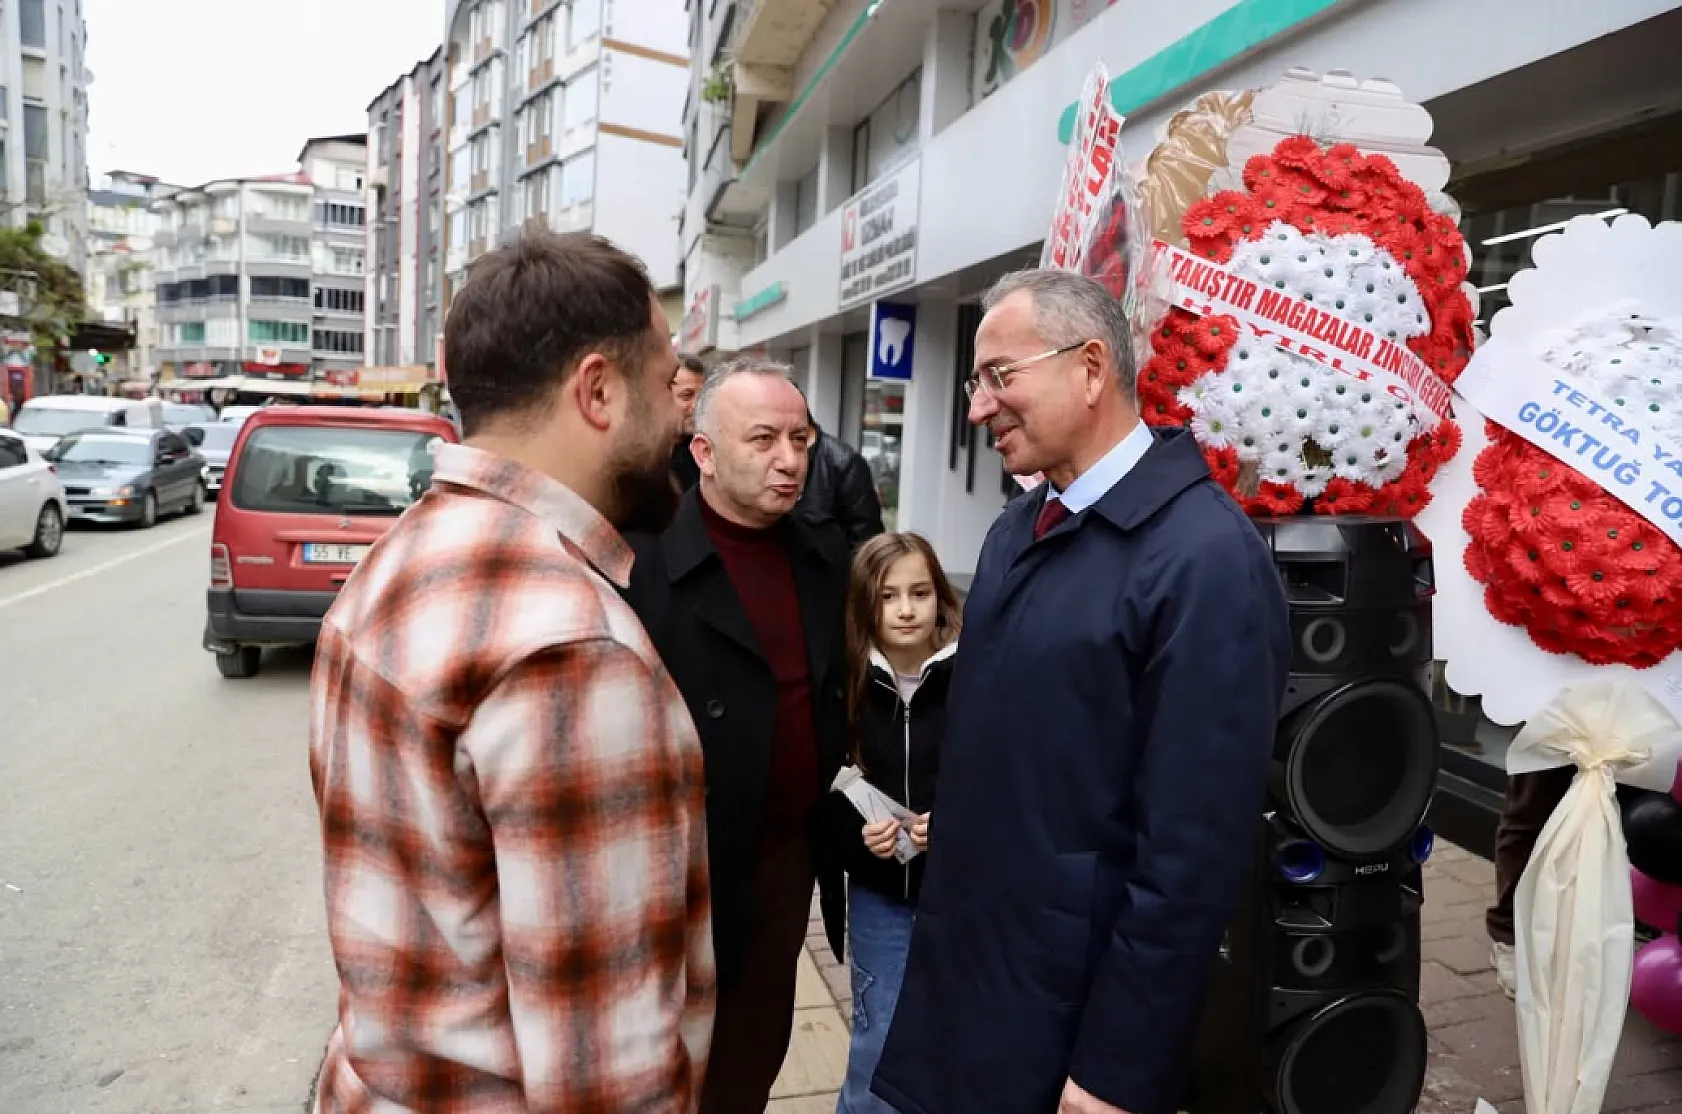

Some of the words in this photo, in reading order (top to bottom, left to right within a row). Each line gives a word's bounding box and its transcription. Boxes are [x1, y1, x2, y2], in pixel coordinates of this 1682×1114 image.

[1171, 252, 1258, 311] TAKIŞTIR
[1254, 288, 1374, 360] MAĞAZALAR
[1517, 400, 1643, 486] GÖKTUĞ
[1552, 379, 1641, 446] TETRA
